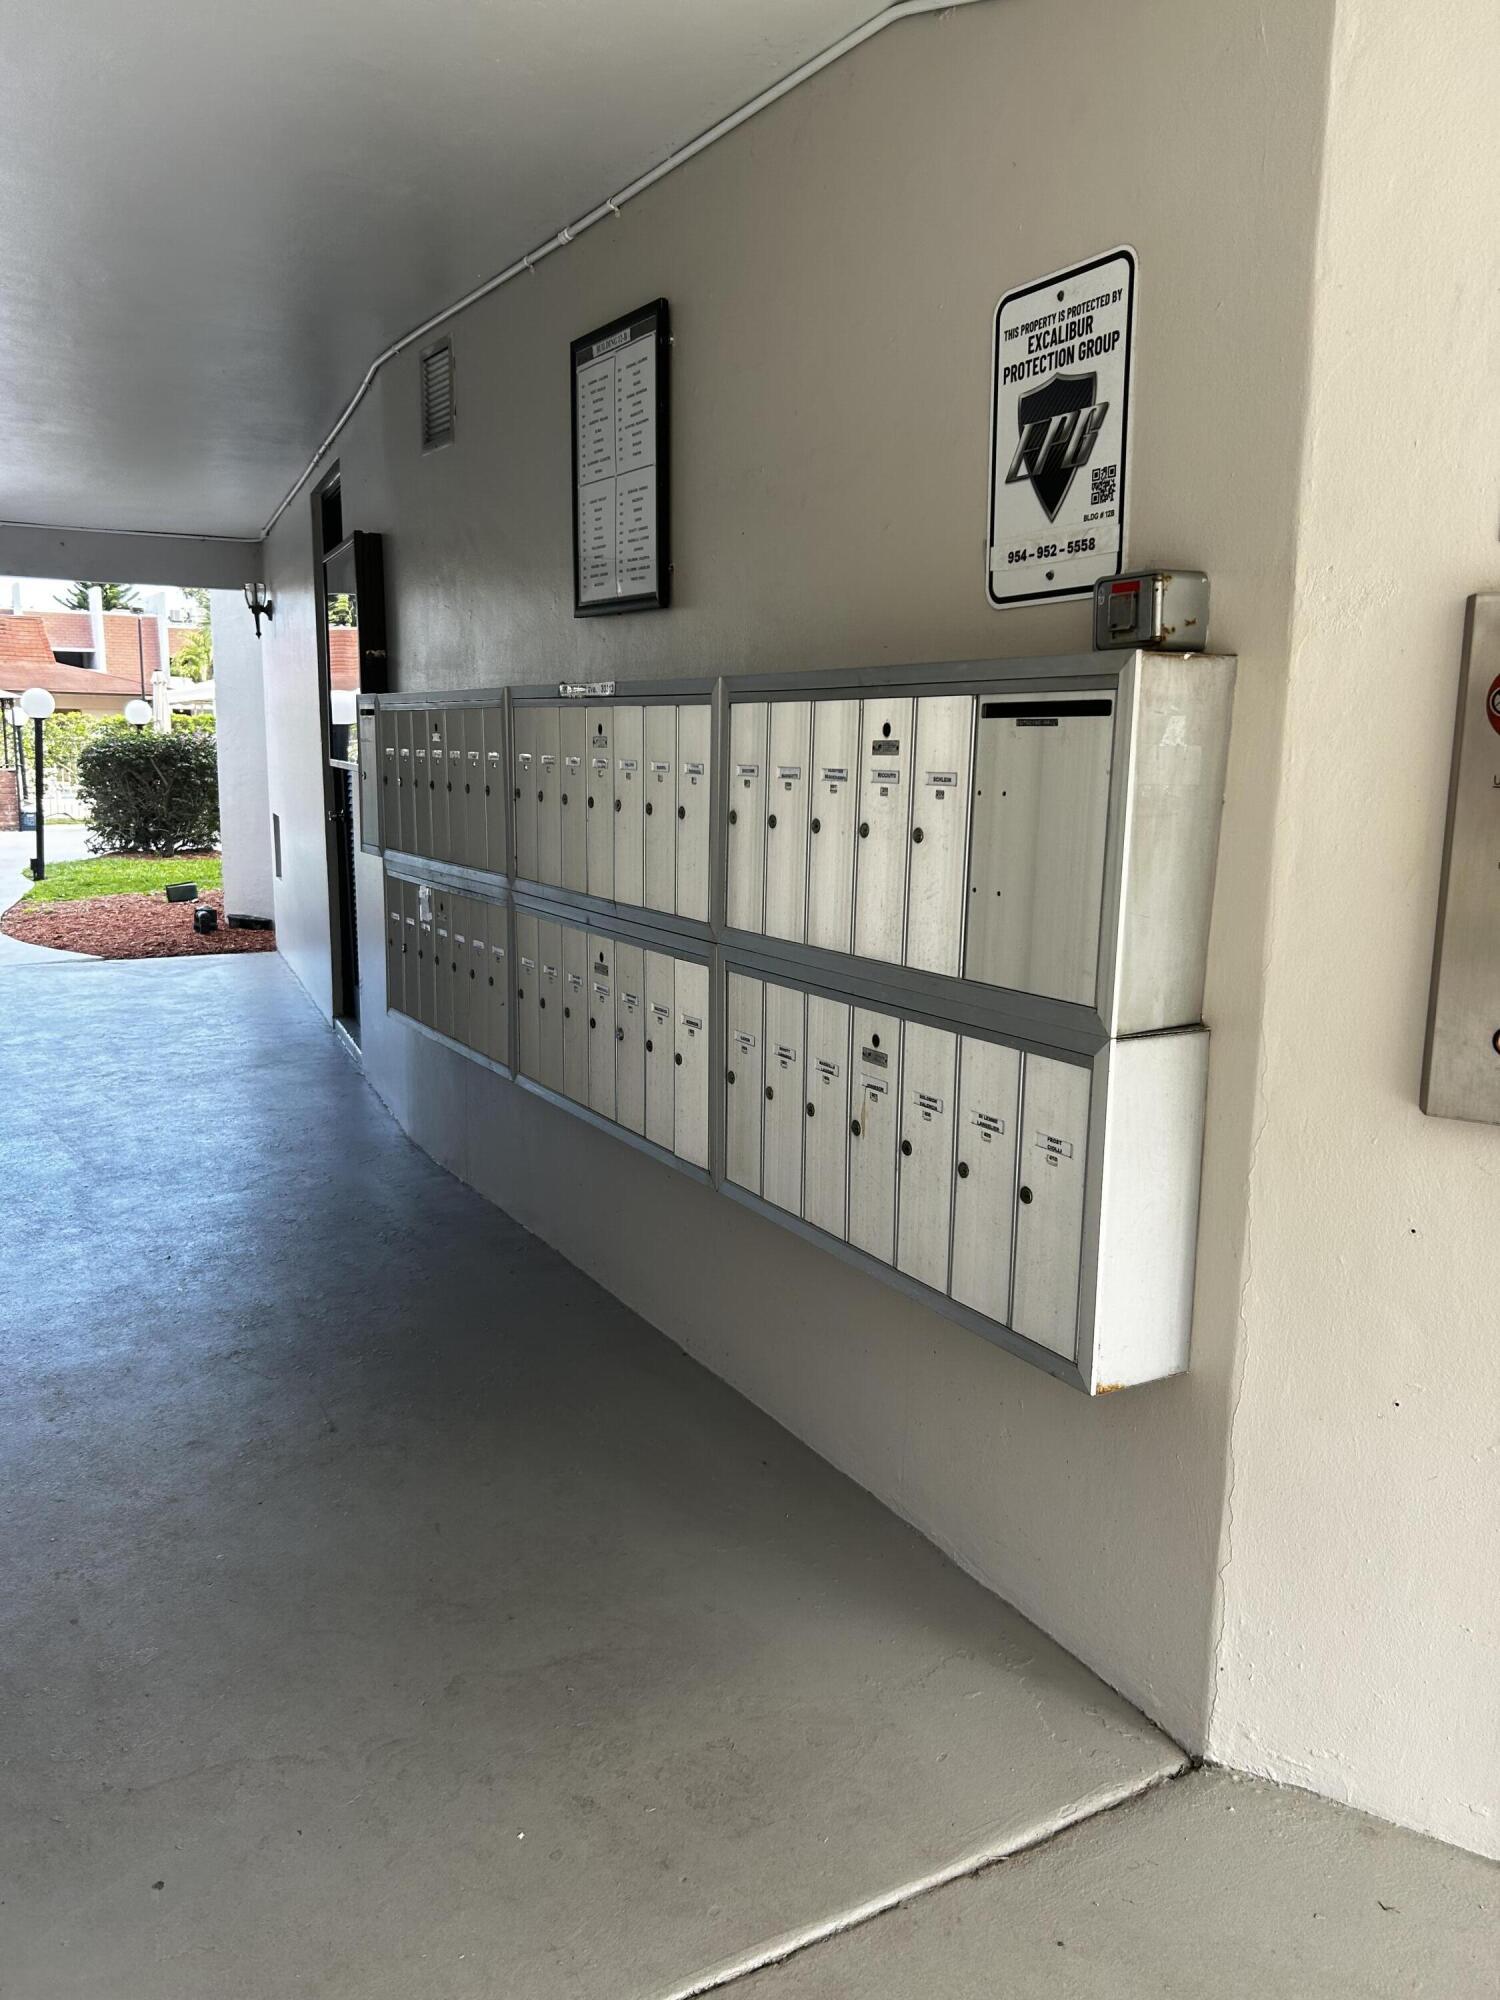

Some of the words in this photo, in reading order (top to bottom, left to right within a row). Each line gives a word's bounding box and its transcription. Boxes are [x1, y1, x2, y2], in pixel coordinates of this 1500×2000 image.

[1004, 326, 1019, 341] THIS
[1021, 313, 1057, 336] PROPERTY
[1058, 309, 1065, 322] IS
[1067, 293, 1110, 319] PROTECTED
[1112, 288, 1123, 303] BY
[1028, 315, 1094, 355] EXCALIBUR
[1003, 344, 1075, 385] PROTECTION
[1078, 330, 1120, 361] GROUP
[1083, 512, 1099, 522] BLDG
[1100, 511, 1105, 519] #
